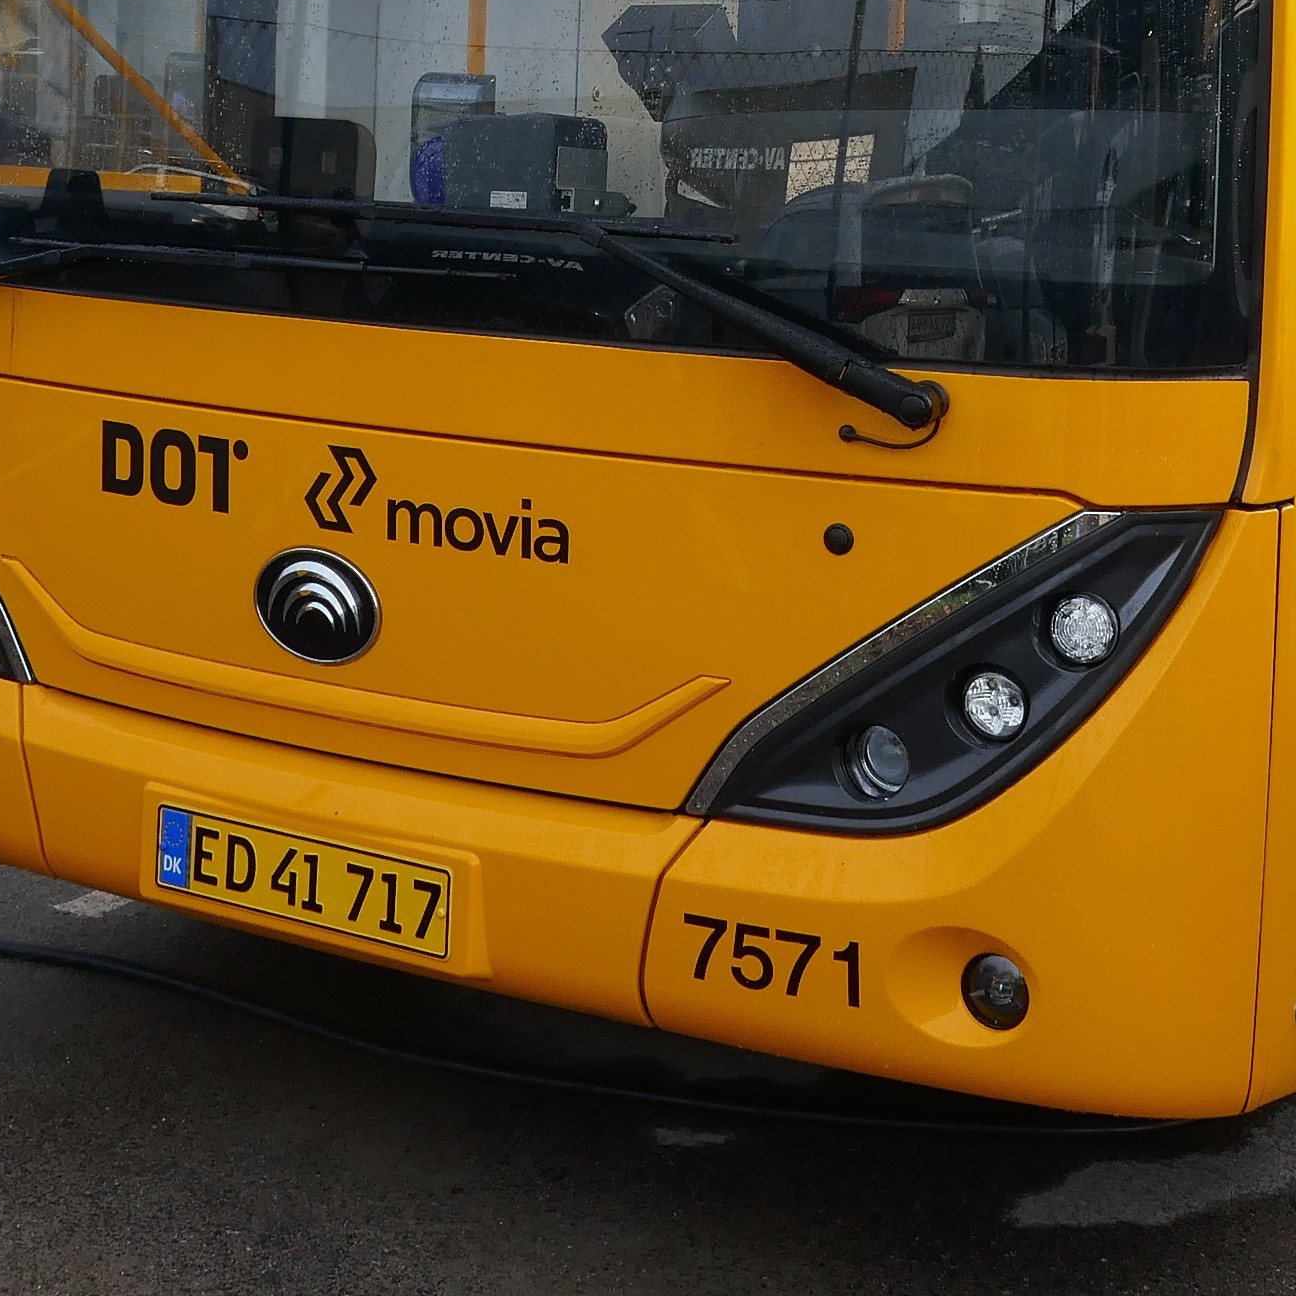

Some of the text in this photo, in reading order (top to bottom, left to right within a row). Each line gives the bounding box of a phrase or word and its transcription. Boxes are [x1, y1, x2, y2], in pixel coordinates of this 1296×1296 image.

[101, 419, 249, 514] DOT
[386, 497, 570, 565] movia
[163, 853, 182, 875] DK
[193, 826, 442, 940] ED 41 717
[683, 912, 861, 1009] 7571
